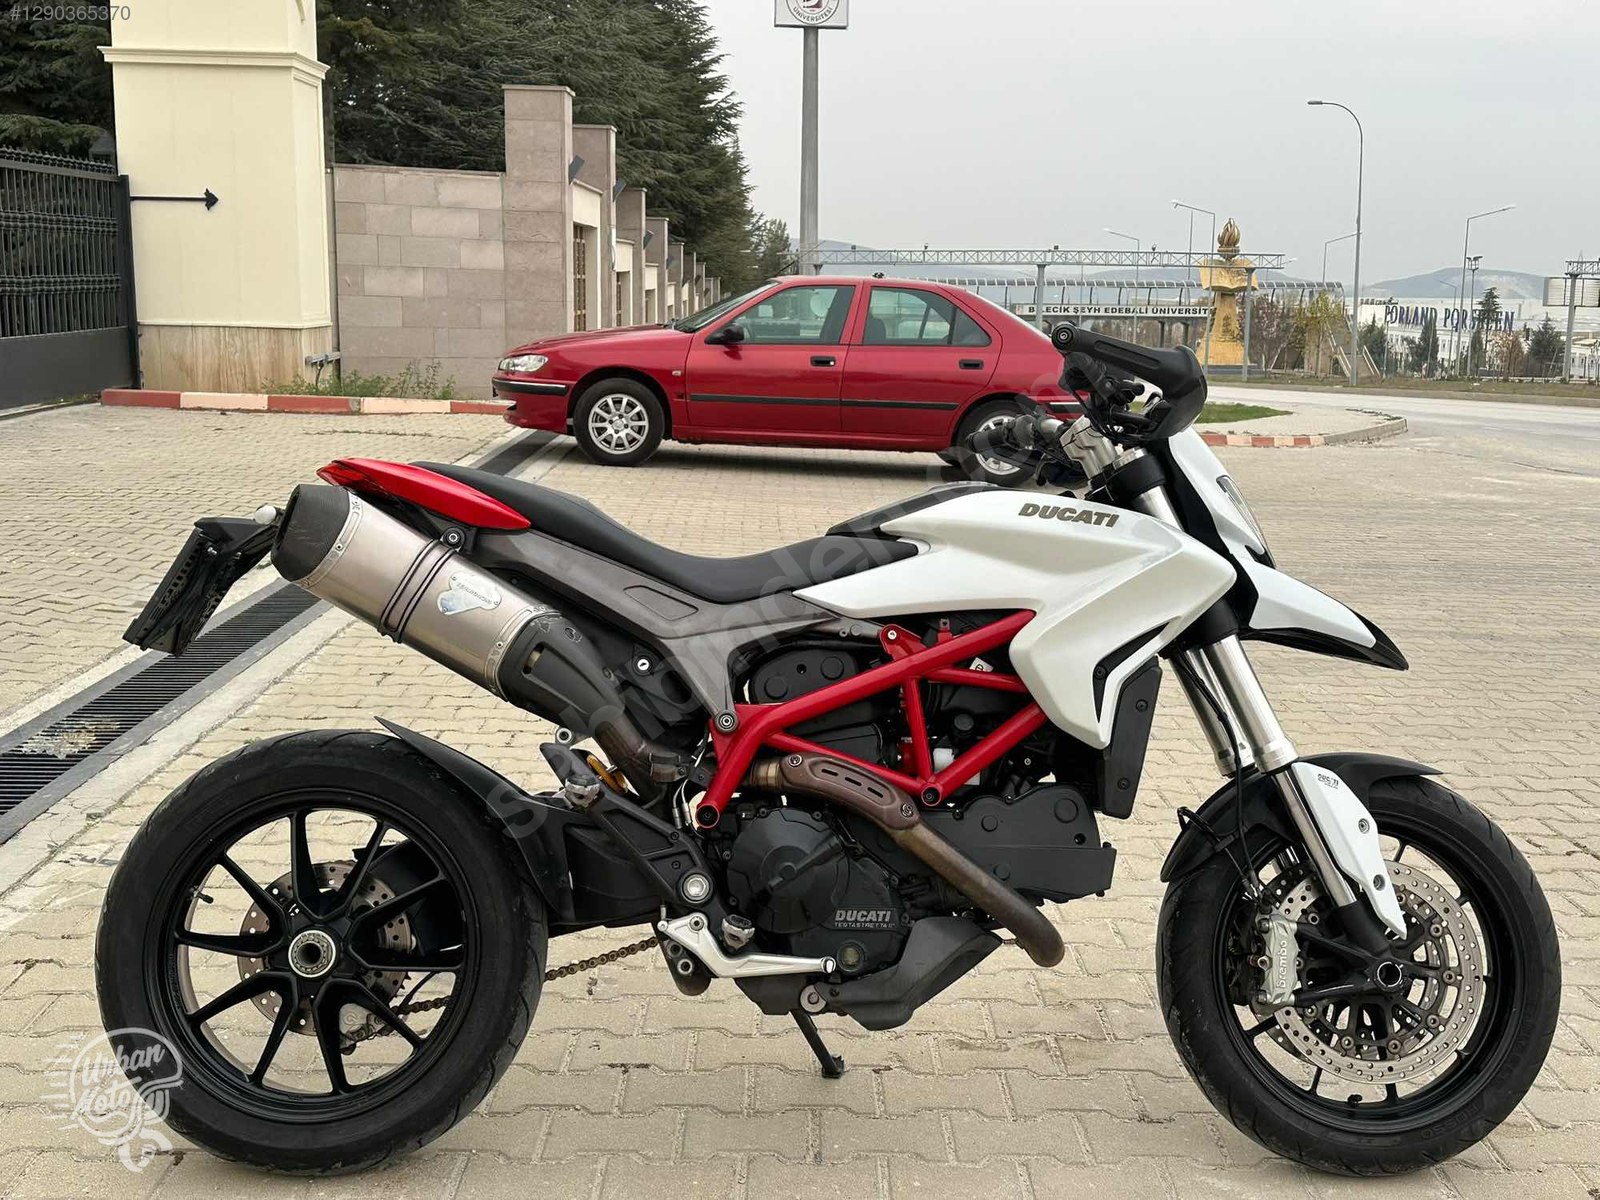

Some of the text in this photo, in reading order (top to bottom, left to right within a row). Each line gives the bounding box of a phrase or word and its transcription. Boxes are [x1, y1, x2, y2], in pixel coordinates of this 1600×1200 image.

[1018, 502, 1120, 528] DUCATI
[835, 910, 891, 922] DUCATI
[1276, 940, 1288, 988] brembo
